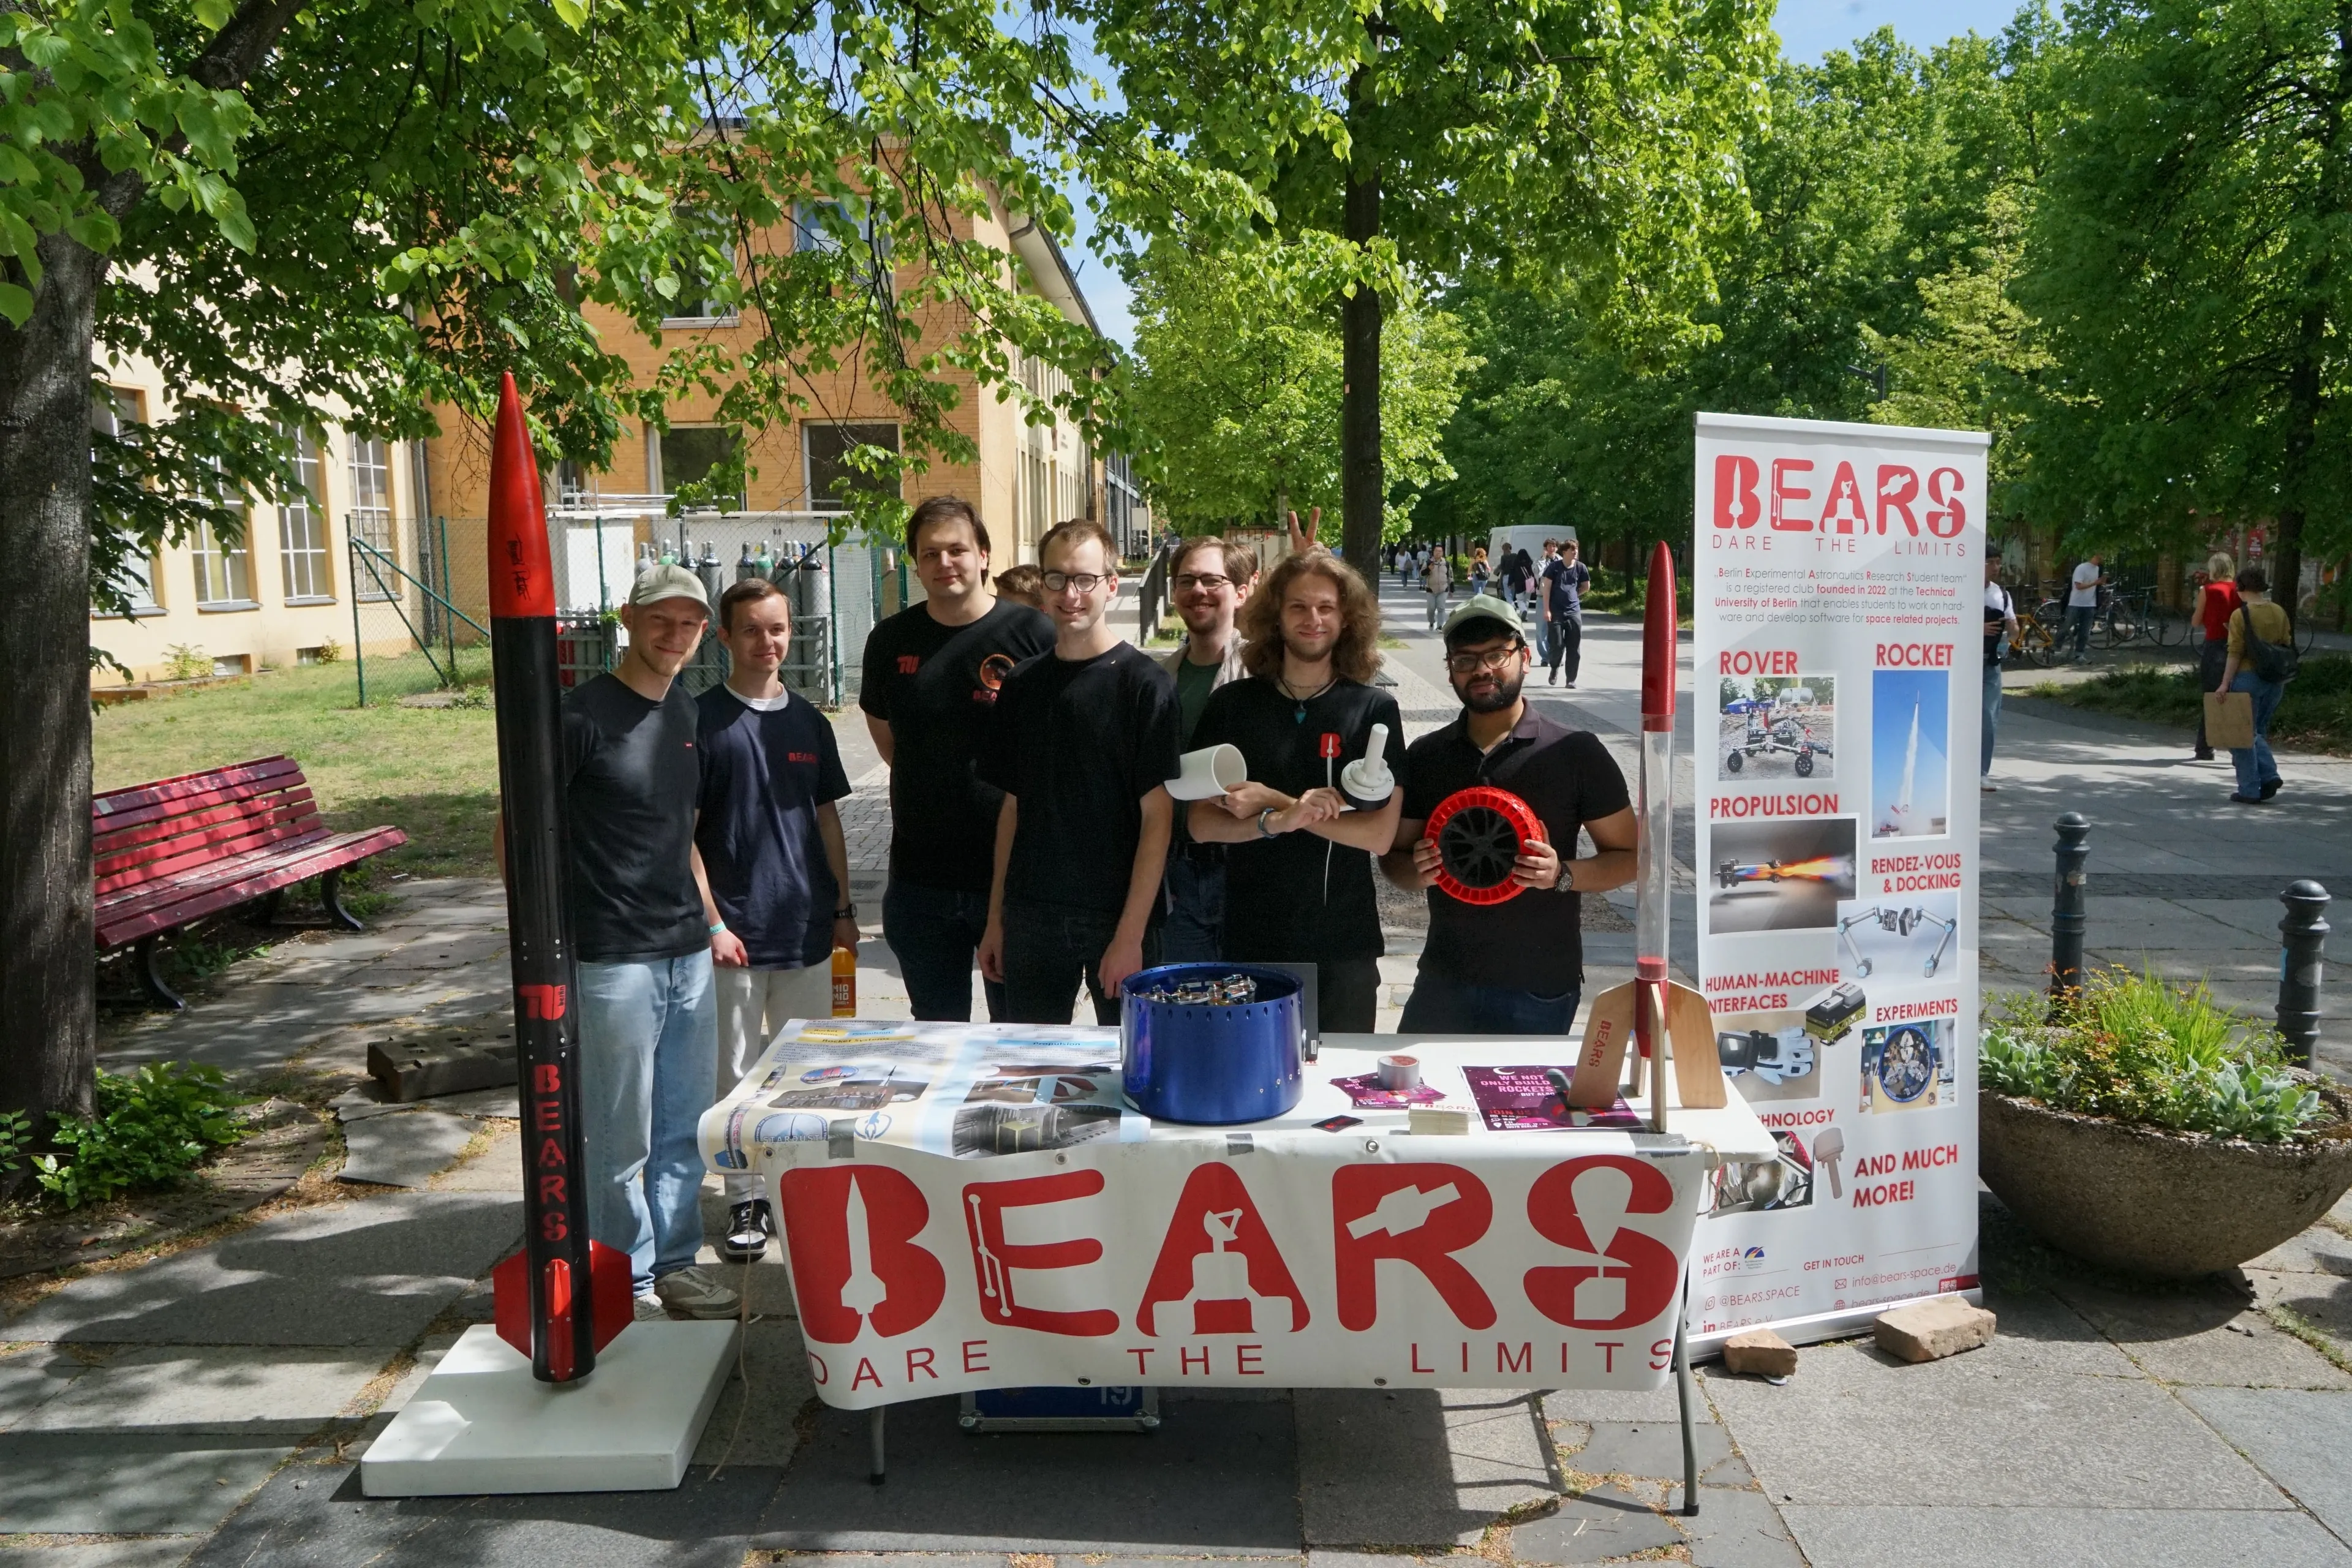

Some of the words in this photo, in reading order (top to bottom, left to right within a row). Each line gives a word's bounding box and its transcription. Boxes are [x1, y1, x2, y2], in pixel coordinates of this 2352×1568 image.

[1714, 455, 1966, 538] BEARS
[1713, 535, 1772, 550] DARE
[1815, 537, 1856, 553] THE
[1894, 541, 1966, 557] LIMITS
[1746, 568, 1806, 581] Experimental
[1808, 569, 1864, 581] Astronautics
[1866, 571, 1904, 581] Research
[1907, 572, 1938, 582] Student
[1726, 582, 1732, 592] is
[1743, 583, 1790, 595] registered
[1793, 584, 1814, 594] club
[1817, 584, 1855, 594] founded
[1858, 585, 1865, 594] in
[1868, 586, 1886, 595] 2022
[1900, 586, 1913, 596] the
[1916, 587, 1955, 597] Technical
[1715, 597, 1758, 609] University
[1761, 598, 1770, 607] of
[1773, 598, 1797, 608] Berlin
[1801, 599, 1820, 608] that
[1823, 599, 1859, 609] enables
[1861, 600, 1895, 609] students
[1898, 600, 1906, 609] to
[1909, 601, 1928, 610] work
[1943, 601, 1965, 611] hard-
[1719, 613, 1743, 622] ware
[1745, 612, 1764, 622] and
[1767, 612, 1806, 624] develop
[1809, 612, 1850, 623] software
[1852, 613, 1864, 623] for
[1866, 614, 1891, 625] space
[1893, 614, 1923, 624] related
[1925, 614, 1960, 626] projects.
[1720, 650, 1798, 675] ROVER
[1876, 644, 1954, 666] ROCKET
[1710, 794, 1838, 818] PROPULSION
[1871, 853, 1961, 874] RENDEZ-VOUS
[1883, 878, 1892, 892] &
[1896, 873, 1961, 891] DOCKING
[1705, 969, 1839, 993] HUMAN-MACHINE
[1708, 993, 1787, 1014] NTERFACES
[1876, 998, 1958, 1022] EXPERIMENTS
[1588, 1020, 1612, 1068] BEARS
[1756, 1109, 1834, 1127] HNOLOGY
[763, 1134, 821, 1143] STARDUST
[532, 1063, 567, 1242] BEARS
[1854, 1155, 1896, 1178] AND
[1902, 1144, 1958, 1170] MUCH
[1853, 1180, 1913, 1208] MORE!
[780, 1155, 1679, 1344] BEARS
[1703, 1254, 1714, 1264] WE
[1716, 1248, 1730, 1261] ARE
[1733, 1248, 1740, 1257] A
[1703, 1264, 1721, 1278] PART
[1724, 1261, 1741, 1272] OF:
[1804, 1261, 1820, 1271] GET
[1822, 1259, 1831, 1268] IN
[1834, 1254, 1864, 1267] TOUCH
[1852, 1262, 1956, 1287] info@bears-space.de
[1719, 1286, 1800, 1306] @BEARS.SPACE
[1852, 1289, 1929, 1308] bears-spacede
[806, 1340, 991, 1392] DARE
[1127, 1343, 1265, 1376] THE
[1411, 1338, 1672, 1373] LIMITS
